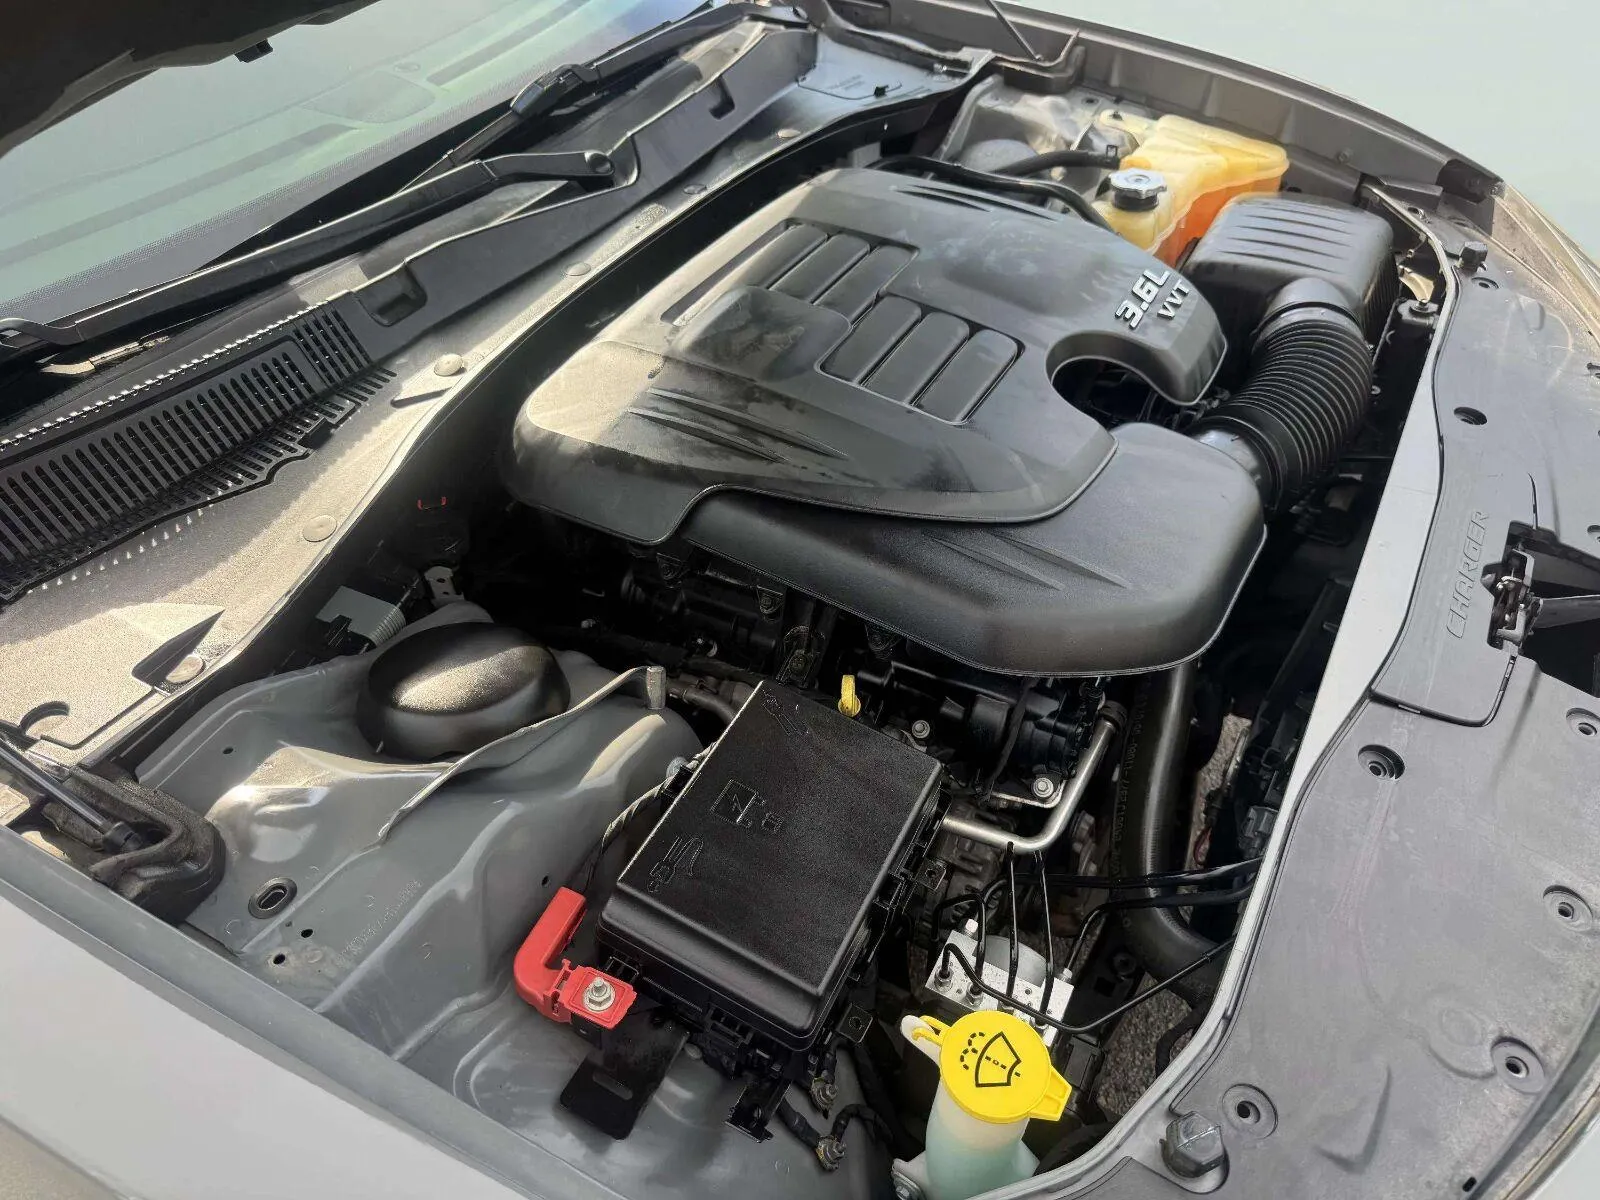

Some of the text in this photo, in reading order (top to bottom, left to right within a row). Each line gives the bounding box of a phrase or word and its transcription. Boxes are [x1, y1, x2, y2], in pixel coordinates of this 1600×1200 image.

[1114, 269, 1171, 330] 3.6L
[1157, 279, 1190, 320] VVT
[1446, 511, 1490, 639] CHARGER
